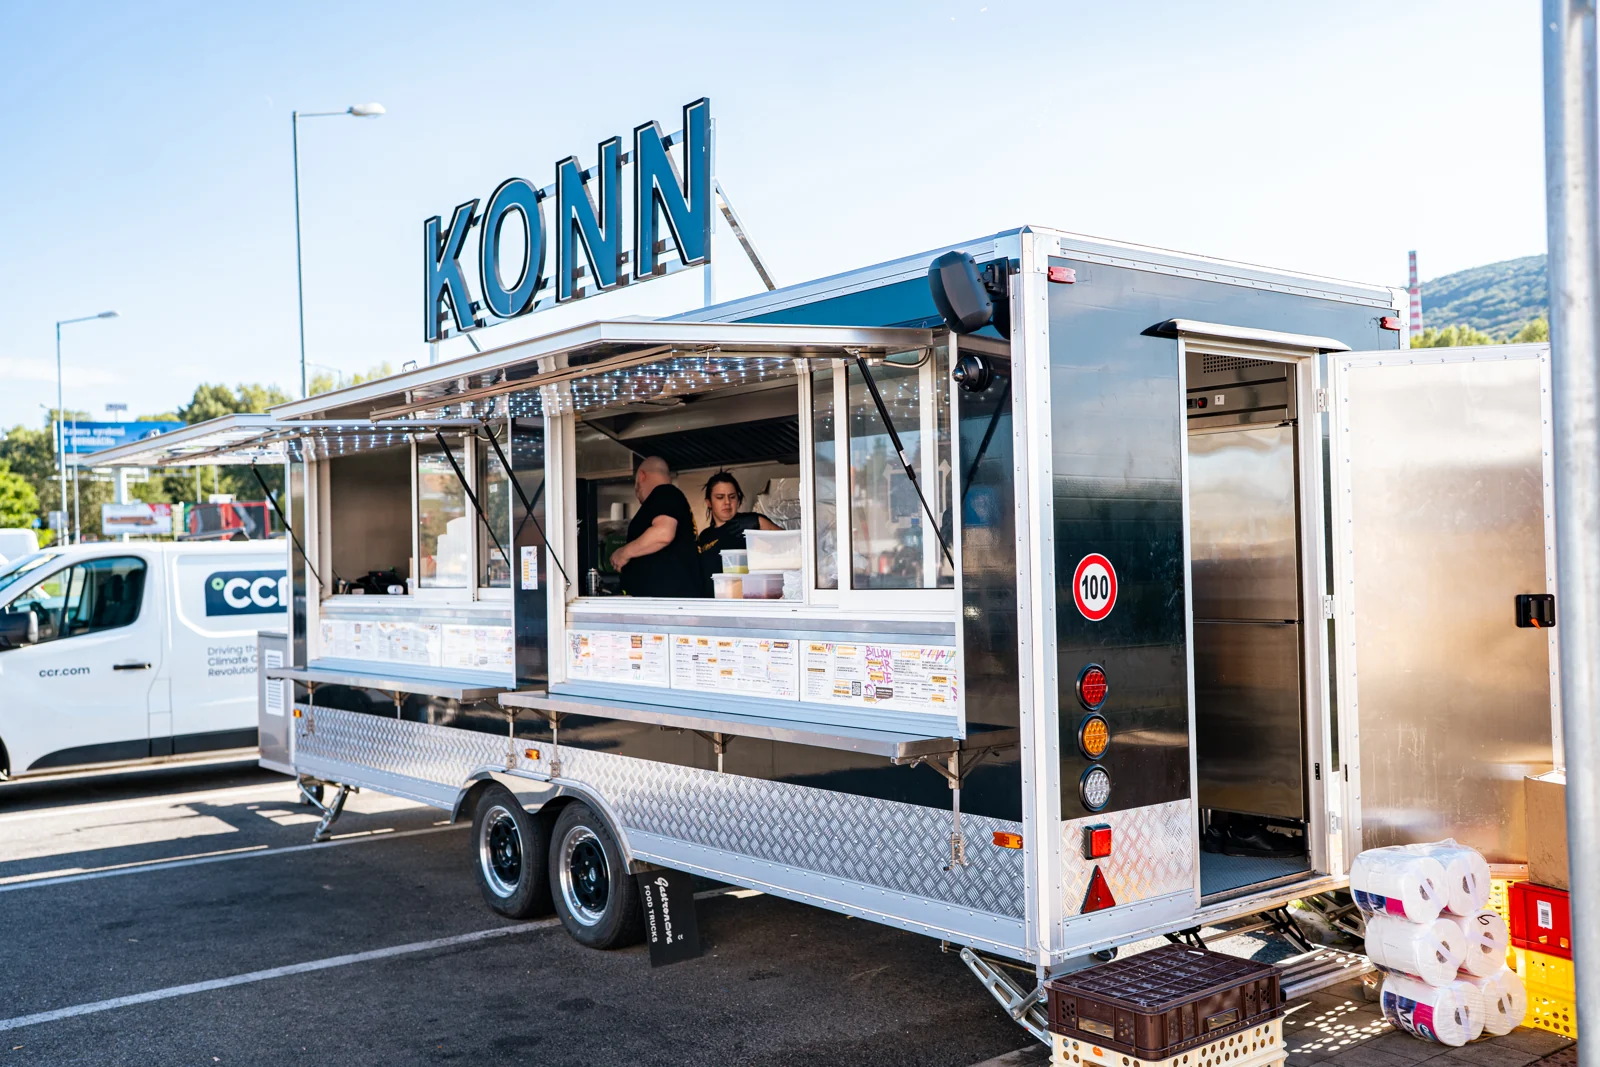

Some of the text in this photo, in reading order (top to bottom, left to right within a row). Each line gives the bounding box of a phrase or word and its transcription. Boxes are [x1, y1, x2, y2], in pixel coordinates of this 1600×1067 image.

[424, 97, 710, 342] KONN
[1082, 574, 1109, 600] 100
[207, 645, 243, 656] Driving
[208, 656, 248, 666] Climate
[39, 667, 90, 677] ccr.com
[644, 885, 658, 943] FOOD TRUCKS
